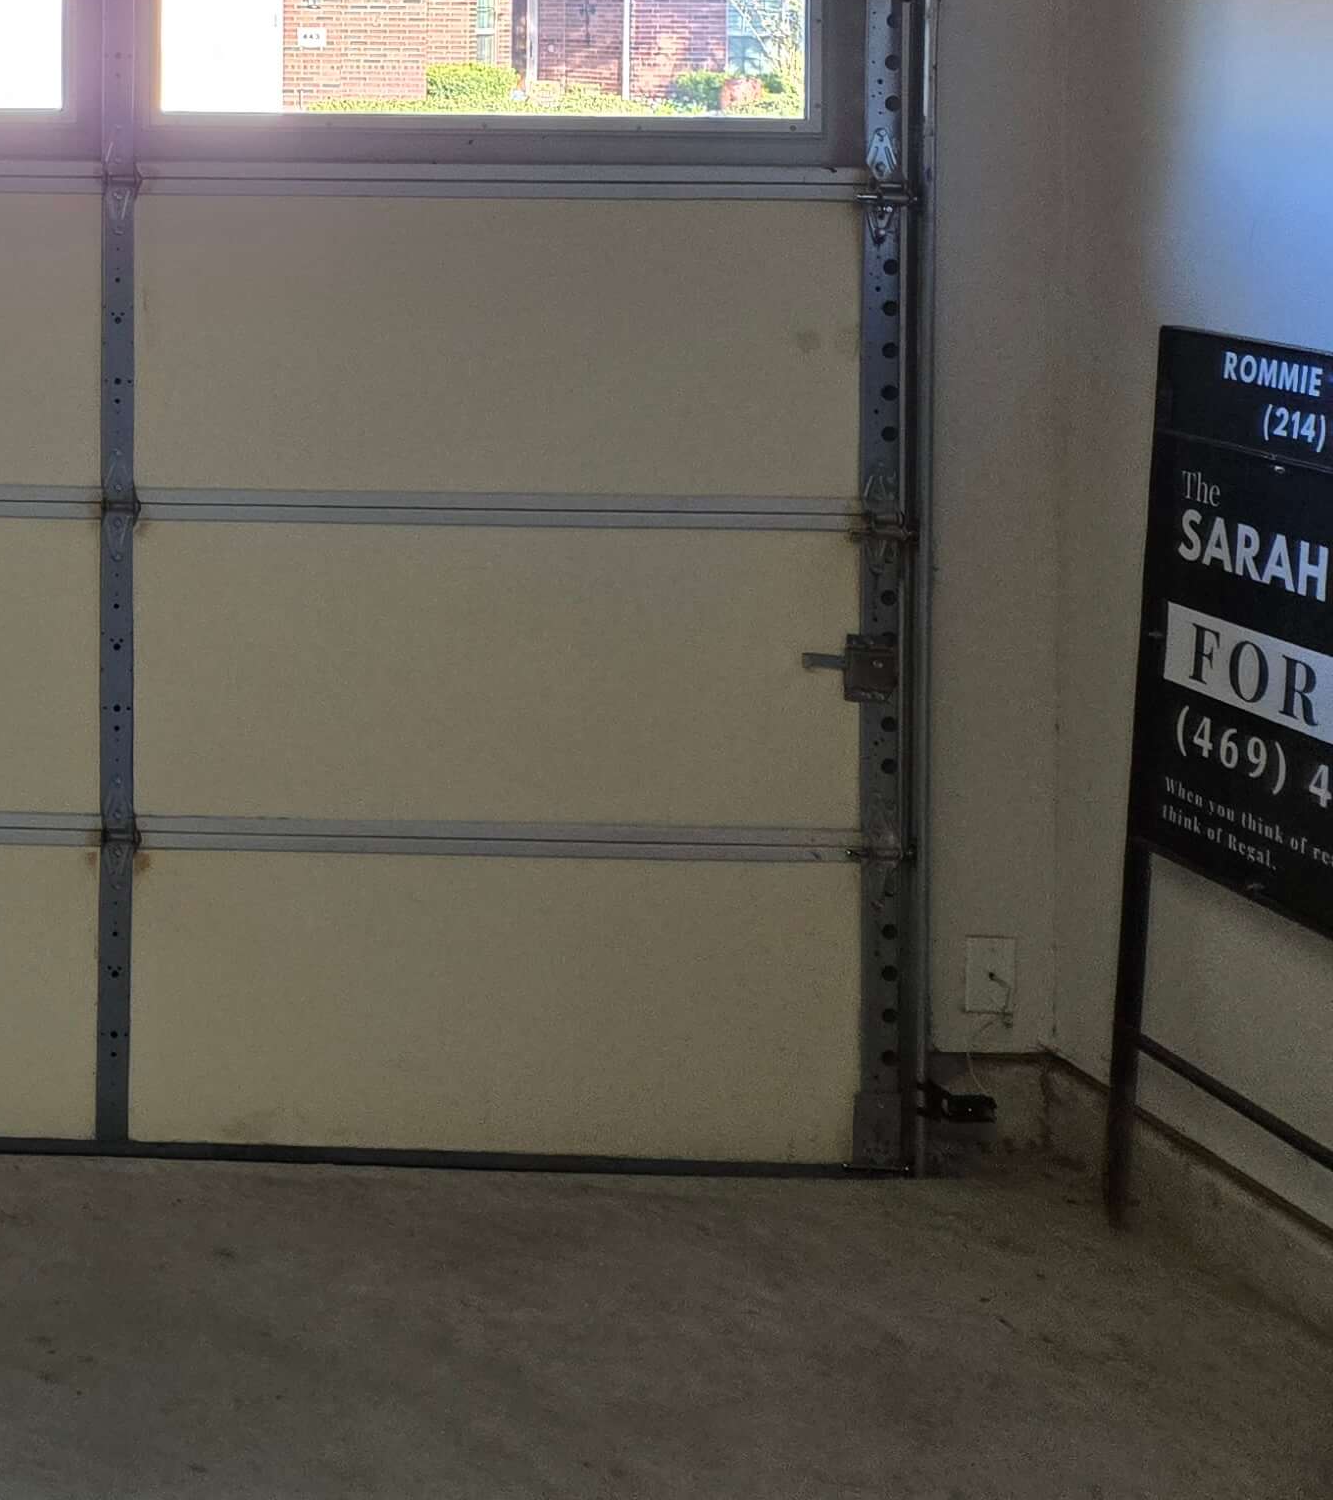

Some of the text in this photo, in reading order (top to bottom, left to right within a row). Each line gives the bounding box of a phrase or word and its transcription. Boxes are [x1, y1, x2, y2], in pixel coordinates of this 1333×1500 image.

[1223, 351, 1323, 397] ROMMIE
[1263, 403, 1326, 453] (214)
[1183, 470, 1221, 507] The
[1178, 509, 1329, 602] SARAH
[1189, 622, 1318, 727] FOR
[1176, 705, 1286, 795] (469)
[1162, 804, 1277, 871] think of Regal.
[1165, 776, 1203, 808] When
[1207, 800, 1235, 822] you
[1241, 811, 1283, 845] think
[1290, 836, 1308, 855] of
